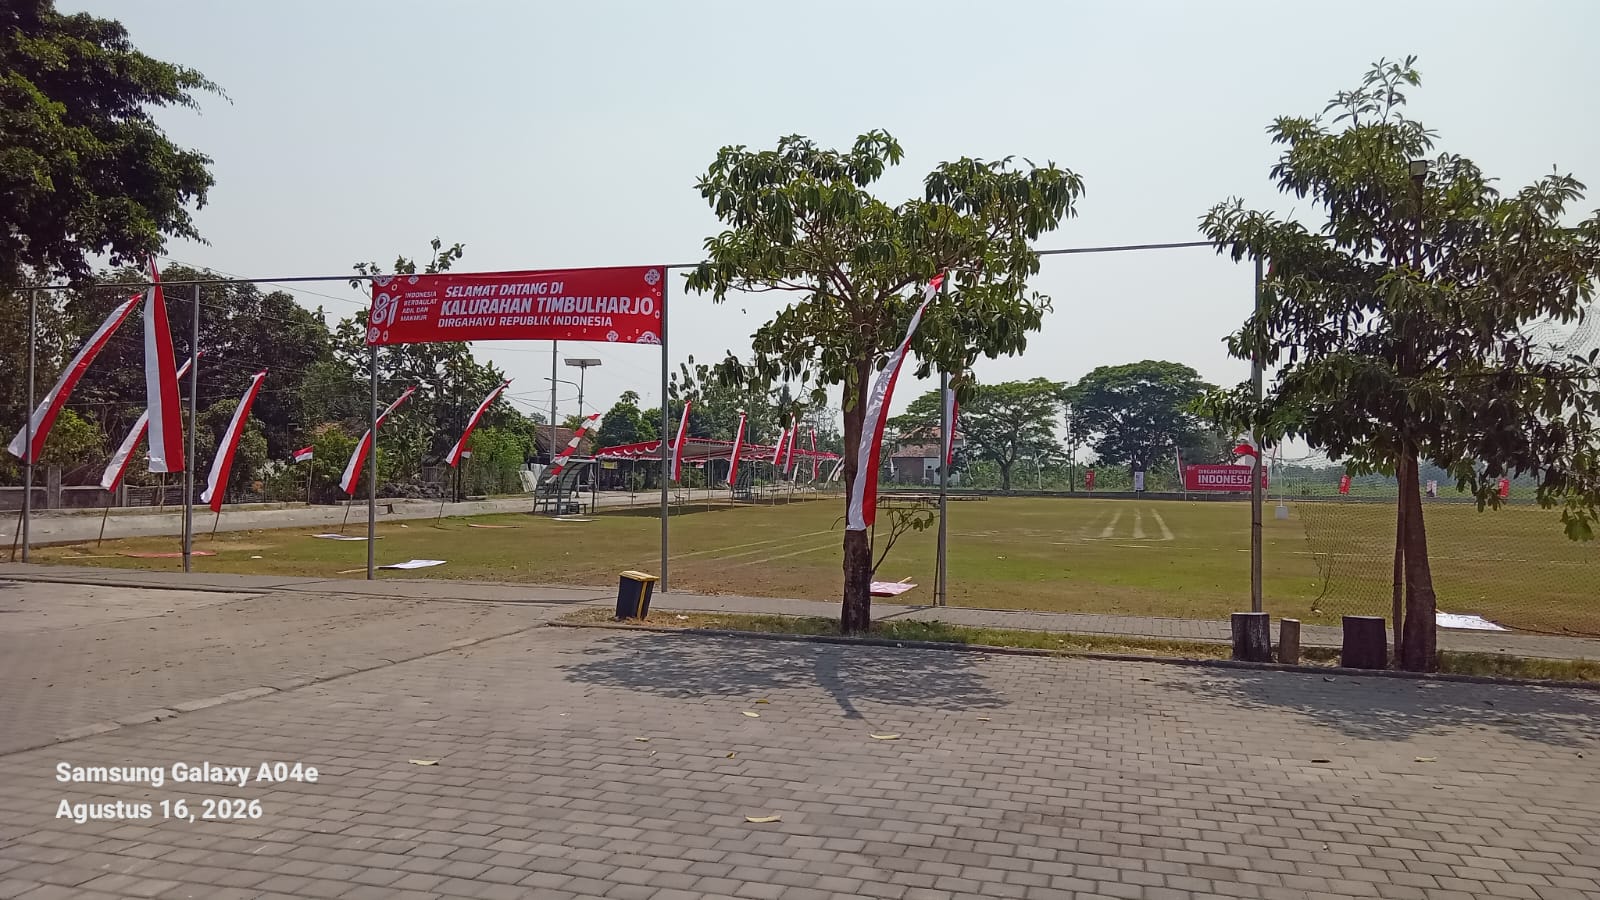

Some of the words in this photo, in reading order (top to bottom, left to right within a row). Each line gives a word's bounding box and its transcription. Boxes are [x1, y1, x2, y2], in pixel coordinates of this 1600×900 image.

[445, 284, 498, 298] SELAMAT
[499, 282, 548, 296] DATANG
[550, 282, 564, 294] DI
[440, 297, 532, 316] KALURAHAN
[536, 296, 654, 316] TIMBULHARJO
[438, 317, 496, 328] DIRGAHAYU
[499, 315, 551, 326] REPUBLIK
[552, 315, 613, 327] INDONESIA
